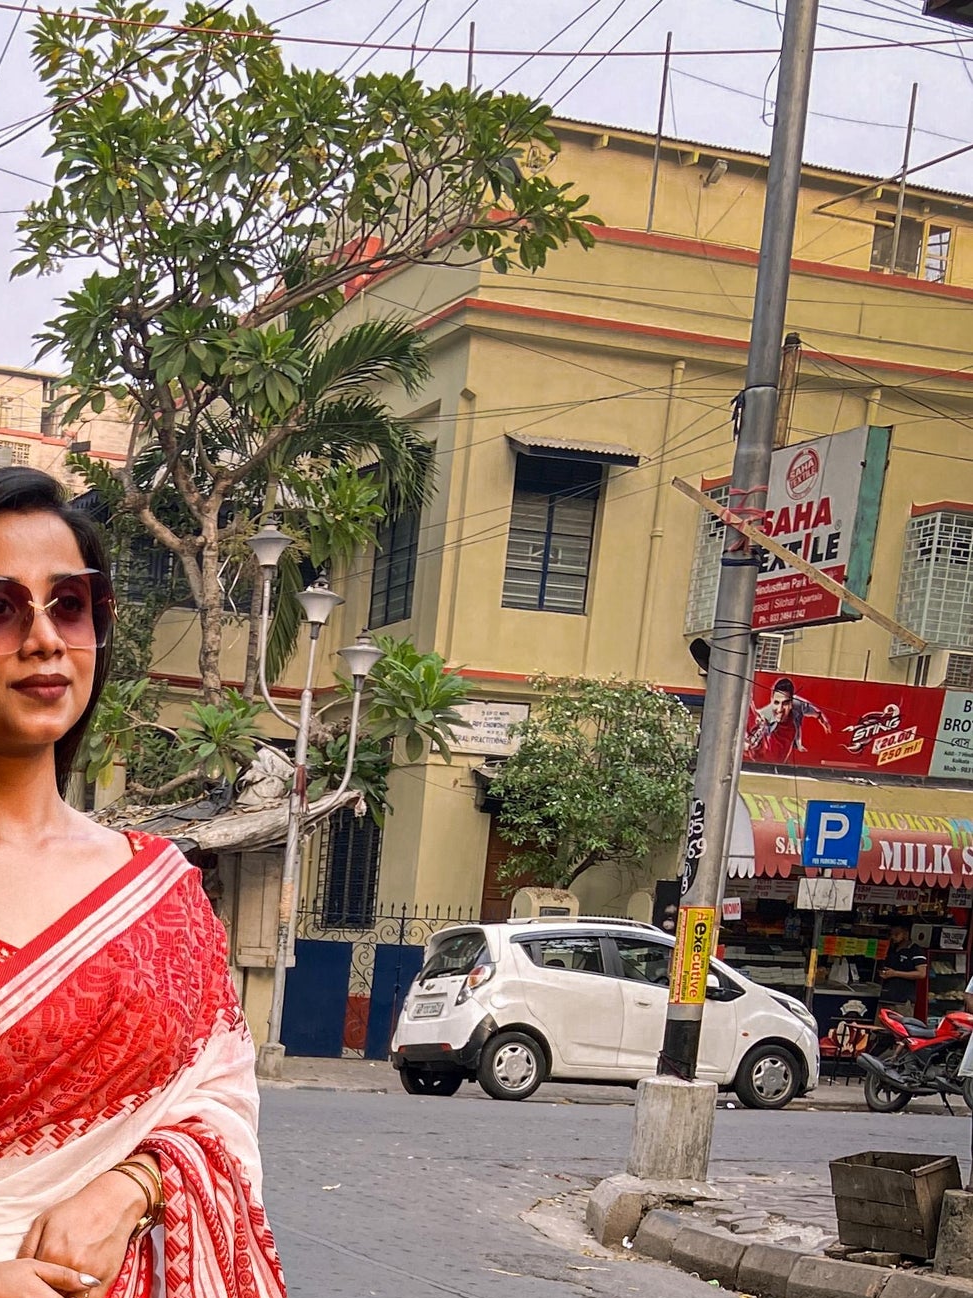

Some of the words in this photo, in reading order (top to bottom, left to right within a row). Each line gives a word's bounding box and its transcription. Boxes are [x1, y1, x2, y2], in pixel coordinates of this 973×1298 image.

[790, 459, 815, 480] SAHA
[761, 497, 832, 537] SAHA
[792, 576, 807, 589] Park
[852, 717, 900, 742] STING
[943, 717, 973, 733] BRO
[880, 748, 902, 762] 250
[816, 812, 850, 856] P
[878, 841, 953, 875] MILK
